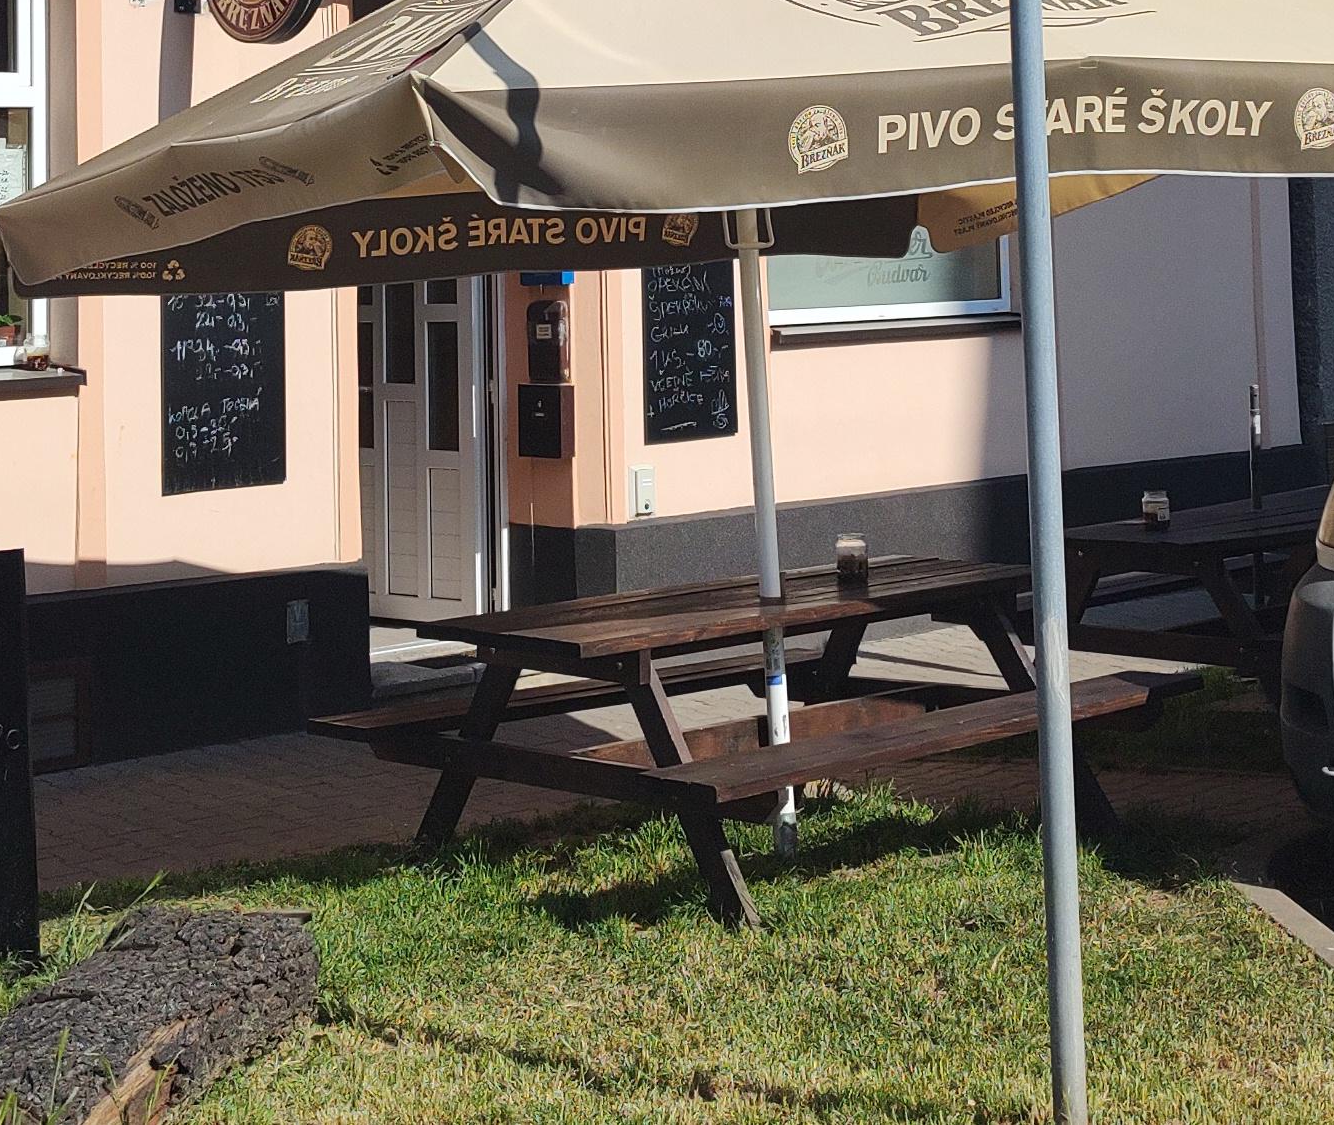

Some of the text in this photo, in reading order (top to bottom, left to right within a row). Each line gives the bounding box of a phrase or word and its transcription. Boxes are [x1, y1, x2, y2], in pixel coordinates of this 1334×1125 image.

[878, 106, 981, 154] PIVO
[993, 89, 1127, 141] SARÉ
[1137, 88, 1273, 137] ŠKOLY
[142, 172, 241, 216] ZALOŽENO
